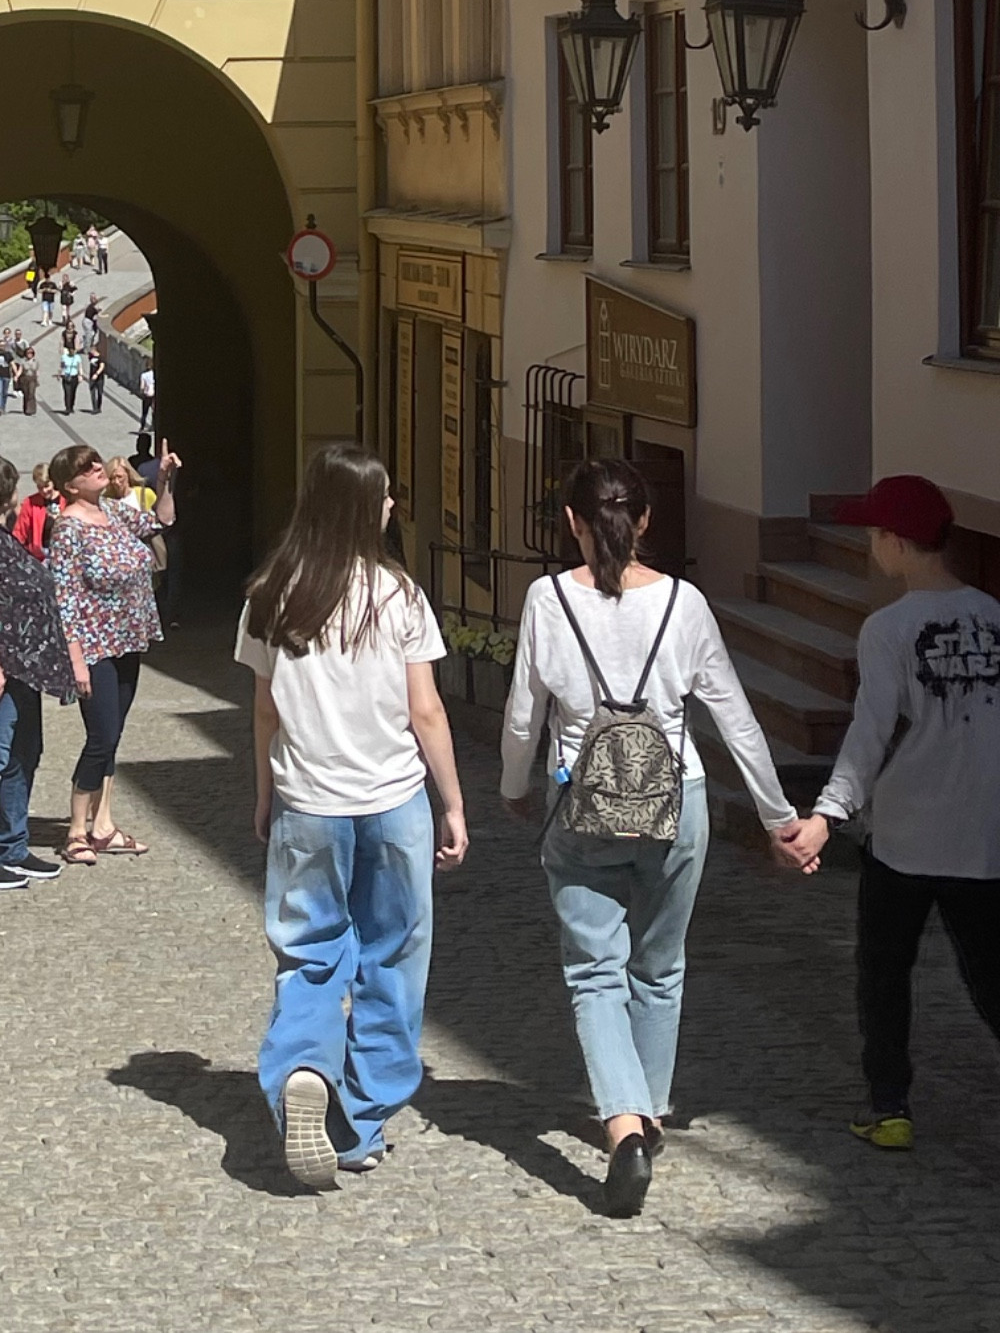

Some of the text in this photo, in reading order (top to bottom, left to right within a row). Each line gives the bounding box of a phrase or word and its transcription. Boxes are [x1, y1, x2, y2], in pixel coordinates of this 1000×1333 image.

[612, 331, 678, 370] WIRYDARZ
[925, 625, 1000, 659] STAR
[926, 654, 1000, 679] WARS
